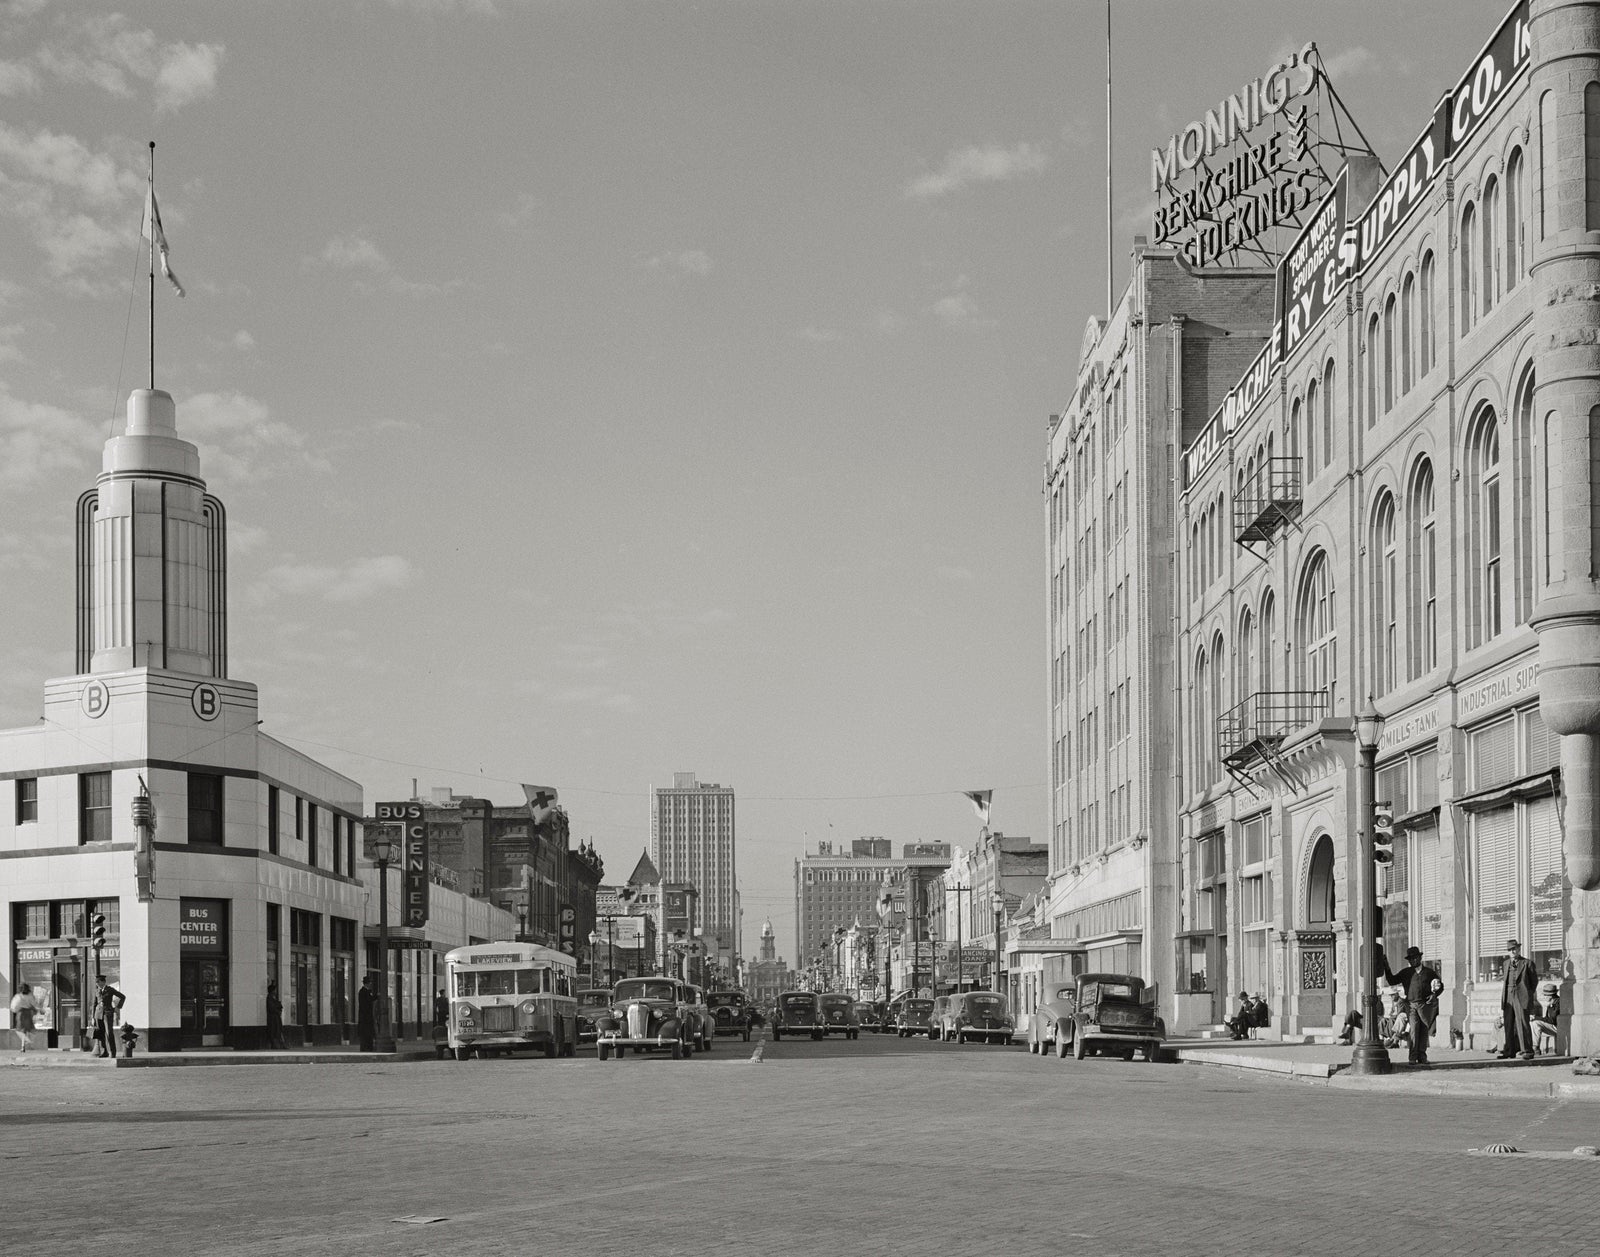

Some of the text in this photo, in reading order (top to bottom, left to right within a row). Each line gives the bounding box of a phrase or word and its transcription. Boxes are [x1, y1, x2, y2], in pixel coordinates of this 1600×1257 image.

[1152, 41, 1317, 192] MONNIG'S
[1153, 131, 1281, 244] BERKSHIRE
[1182, 168, 1310, 268] STOCKINGS
[1310, 196, 1337, 249] WORTH
[1189, 419, 1220, 483] WELL
[1222, 280, 1316, 433] MACHIERY
[1322, 258, 1336, 305] &
[1337, 134, 1435, 276] SUPPLY
[1452, 54, 1502, 142] CO.
[88, 685, 102, 713] B
[200, 688, 216, 715] B
[1460, 676, 1513, 716] INDUSTRIAL
[379, 806, 421, 819] BUS
[409, 825, 424, 921] CENTER
[180, 921, 218, 932] CENTER
[189, 908, 209, 918] BUS
[560, 908, 575, 954] BUS
[181, 935, 217, 945] DRUGS
[476, 957, 513, 965] LAKEVIEW
